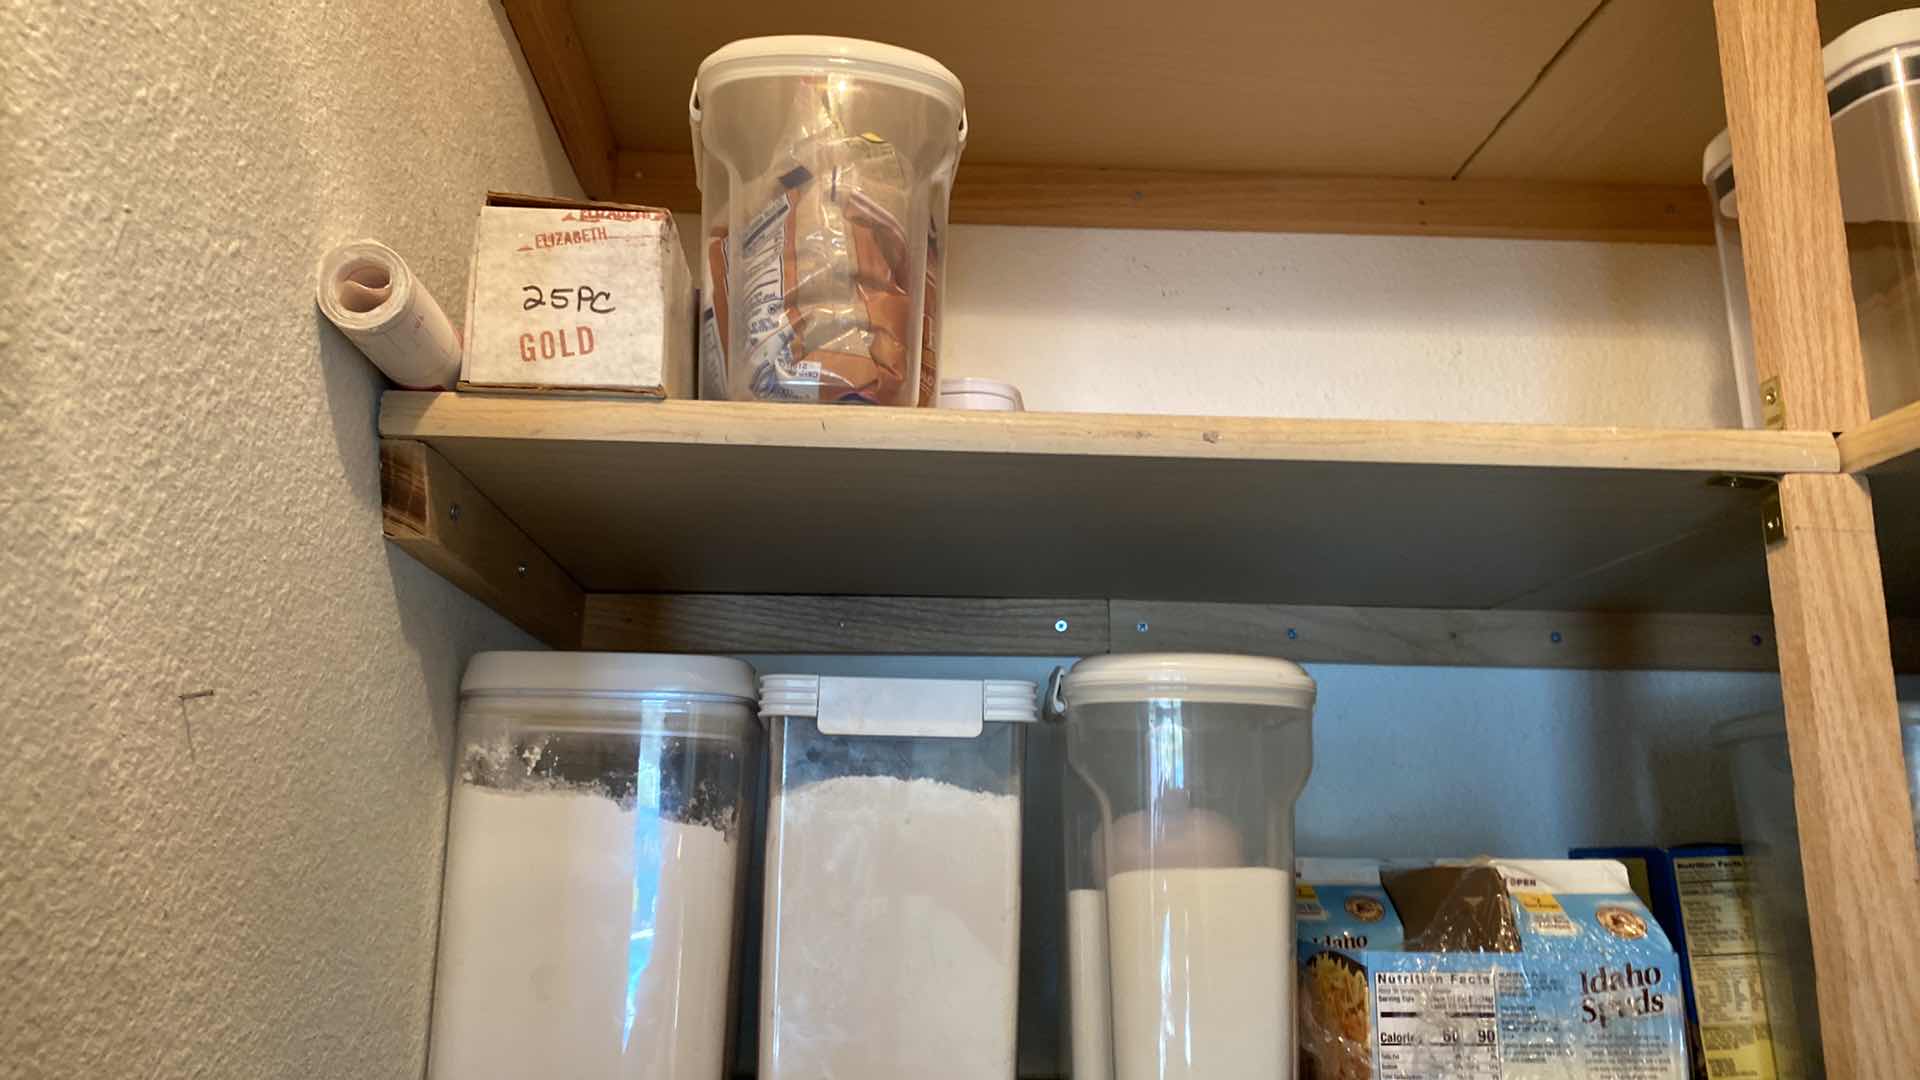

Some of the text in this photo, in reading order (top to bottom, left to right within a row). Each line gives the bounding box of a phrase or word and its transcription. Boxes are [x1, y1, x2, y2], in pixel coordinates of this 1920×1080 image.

[535, 226, 608, 249] ELIZABETH
[519, 325, 595, 362] GOLD
[1510, 877, 1536, 887] OPEN
[1377, 973, 1443, 984] Nutrition
[1450, 973, 1490, 985] Facts
[1580, 962, 1661, 995] Idaho
[1582, 988, 1664, 1028] Spds
[1477, 1029, 1495, 1043] 90
